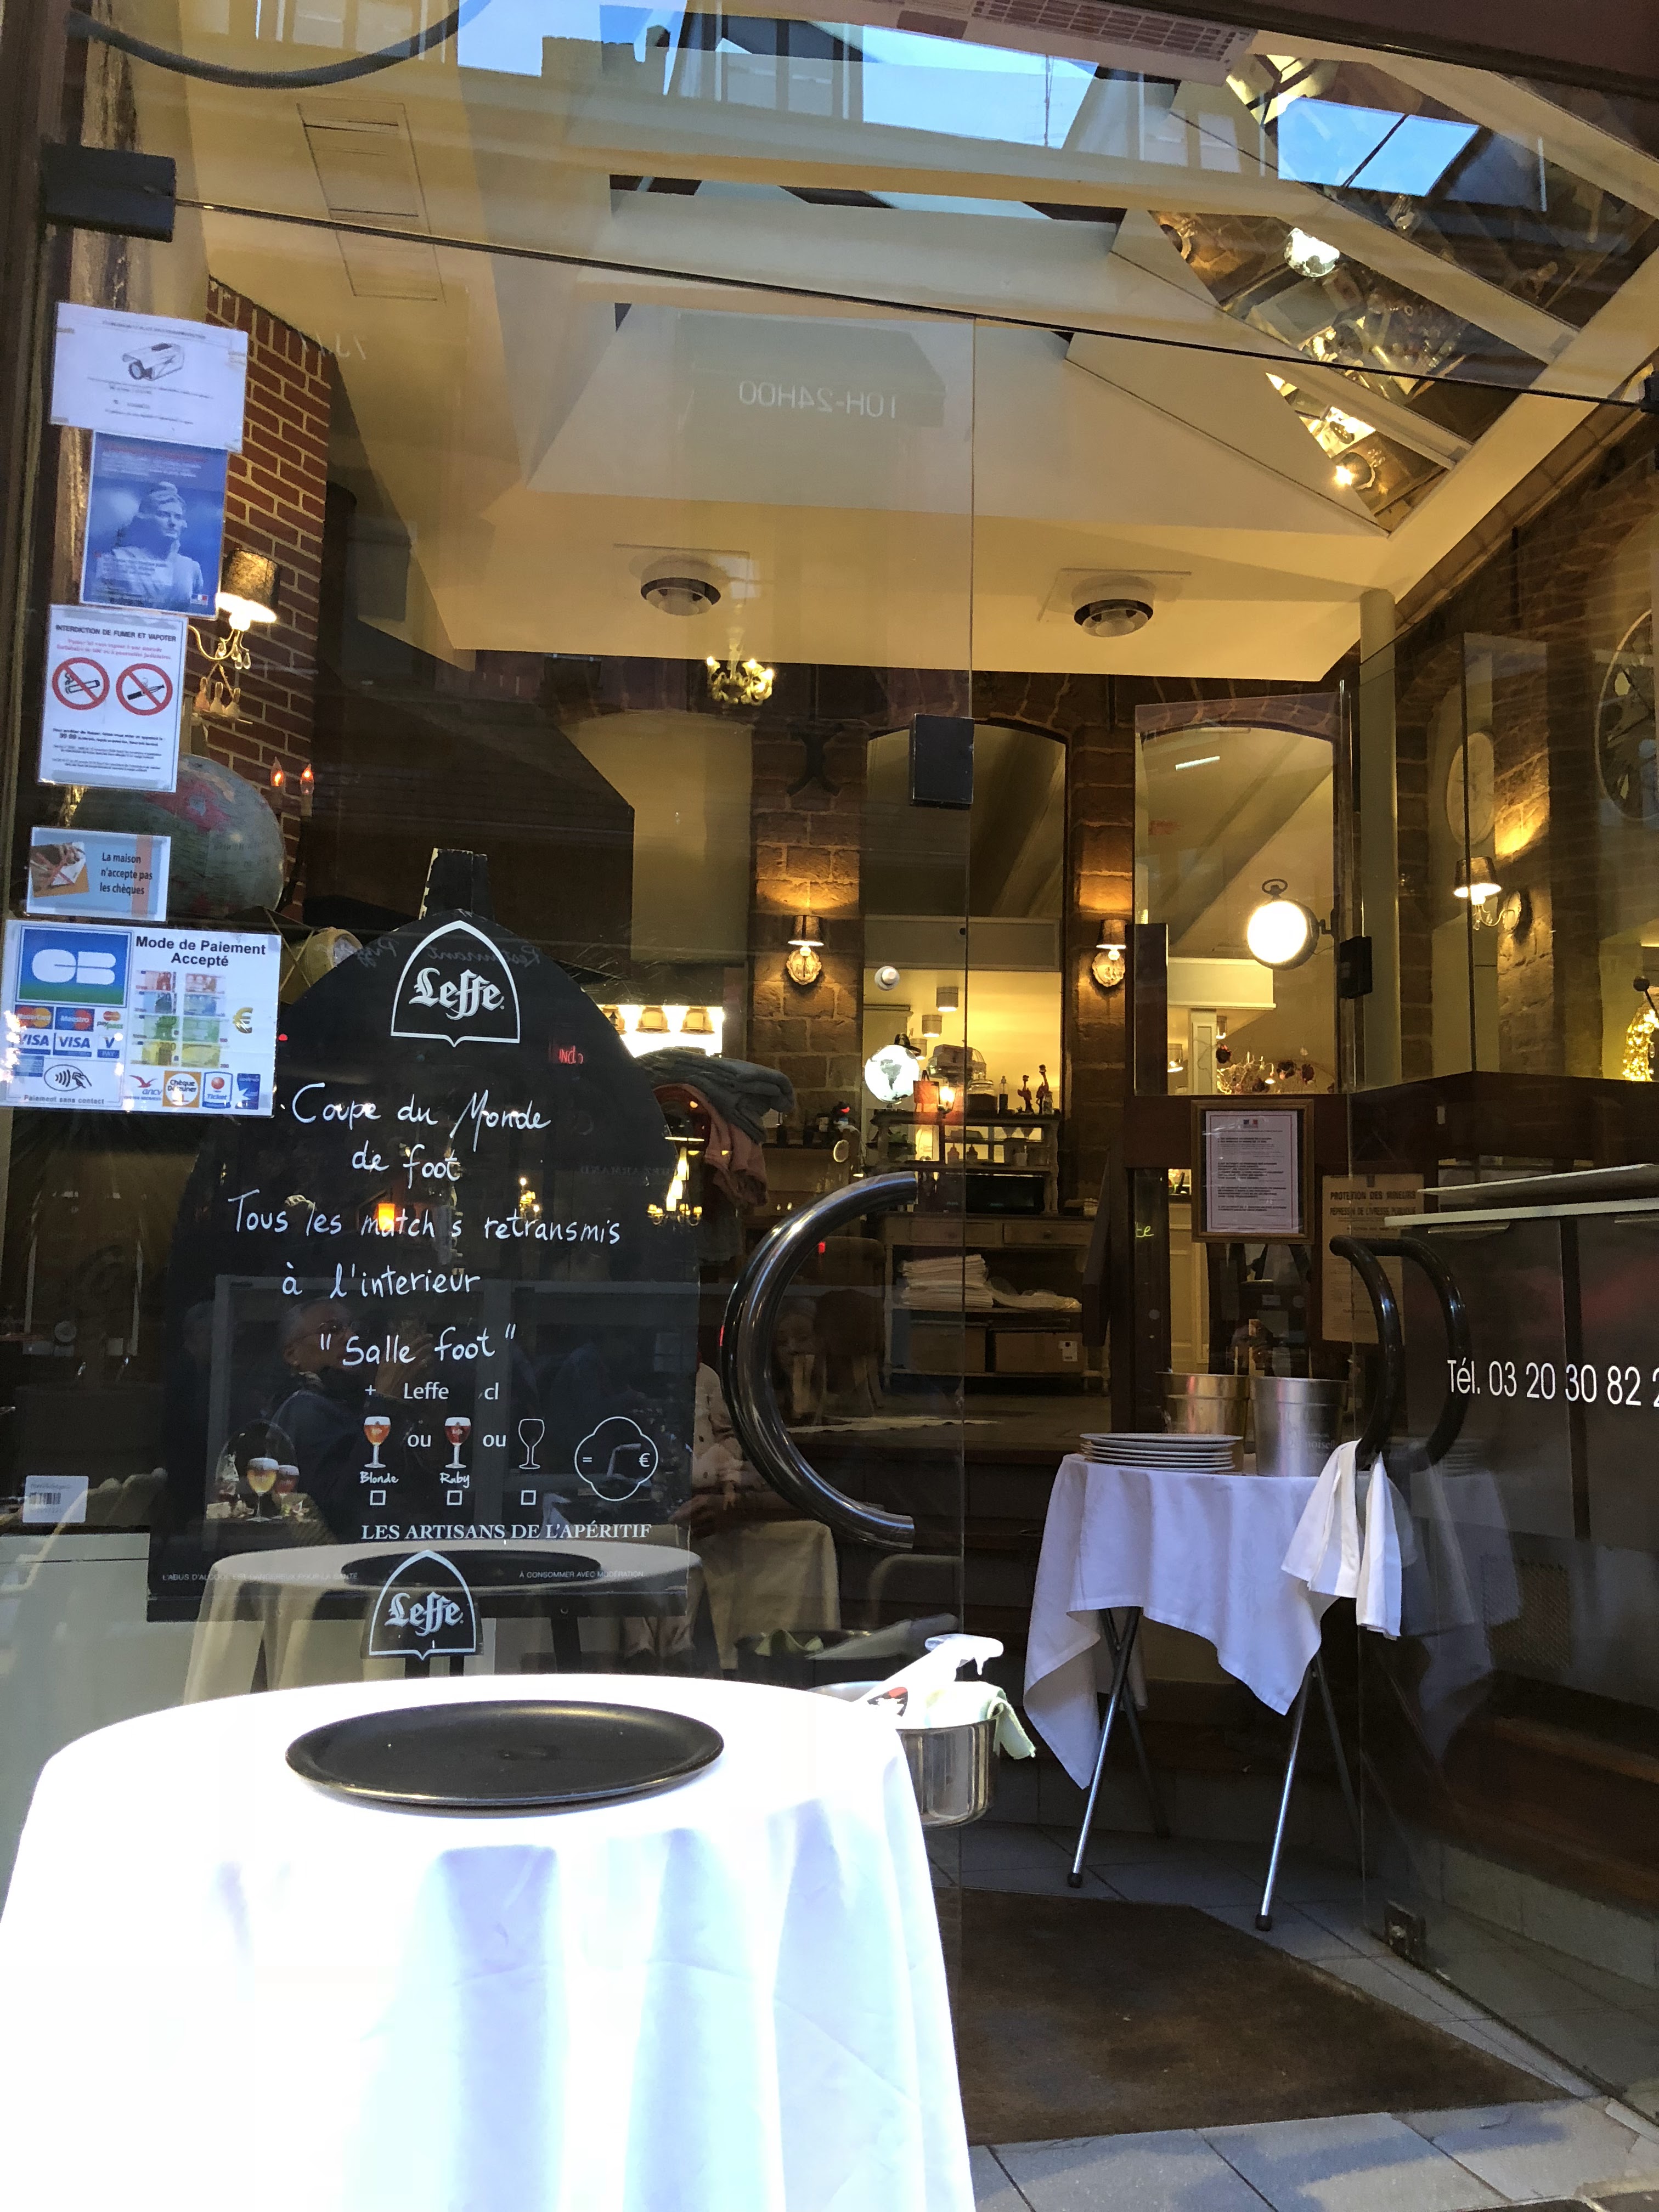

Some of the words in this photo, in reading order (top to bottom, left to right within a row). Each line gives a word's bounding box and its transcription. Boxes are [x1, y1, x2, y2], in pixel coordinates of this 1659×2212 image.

[55, 624, 100, 635] INTERDICTION
[148, 633, 176, 642] VAPOTER
[101, 852, 111, 862] La
[113, 854, 141, 864] maison
[101, 867, 138, 880] n'accepte
[139, 871, 153, 881] pas
[100, 882, 111, 892] les
[112, 883, 145, 896] chèques
[136, 936, 174, 949] Mode
[179, 939, 196, 950] de
[201, 940, 267, 955] Paiement
[171, 953, 229, 968] Accepté
[408, 967, 504, 1020] Leffe
[22, 1034, 49, 1046] VISA
[59, 1036, 91, 1048] VISA
[24, 1094, 57, 1103] Paiement
[292, 1082, 381, 1130] Coupe
[397, 1094, 438, 1125] du
[449, 1090, 551, 1152] Monde
[352, 1140, 390, 1172] de
[403, 1143, 460, 1189] foot
[1330, 1191, 1367, 1200] PROTETION
[1369, 1190, 1383, 1199] DES
[228, 1189, 289, 1232] Tous
[306, 1201, 342, 1236] les
[484, 1209, 620, 1244] retransmis
[282, 1261, 303, 1295] à
[404, 1381, 449, 1400] Leffe
[484, 1382, 499, 1400] cl
[1447, 1357, 1480, 1394] Tél.
[1489, 1361, 1517, 1397] 03
[1526, 1362, 1556, 1400] 20
[1565, 1364, 1597, 1403] 30
[1607, 1365, 1641, 1406] 82
[407, 1434, 432, 1447] ou
[483, 1434, 506, 1447] ou
[359, 1471, 399, 1484] Blonde
[439, 1471, 470, 1488] Ruby
[361, 1525, 400, 1540] LES
[404, 1524, 506, 1540] ARTISANS
[511, 1524, 540, 1539] DE
[545, 1520, 652, 1539] L'APÉRITIF
[384, 1591, 464, 1637] Leffe
